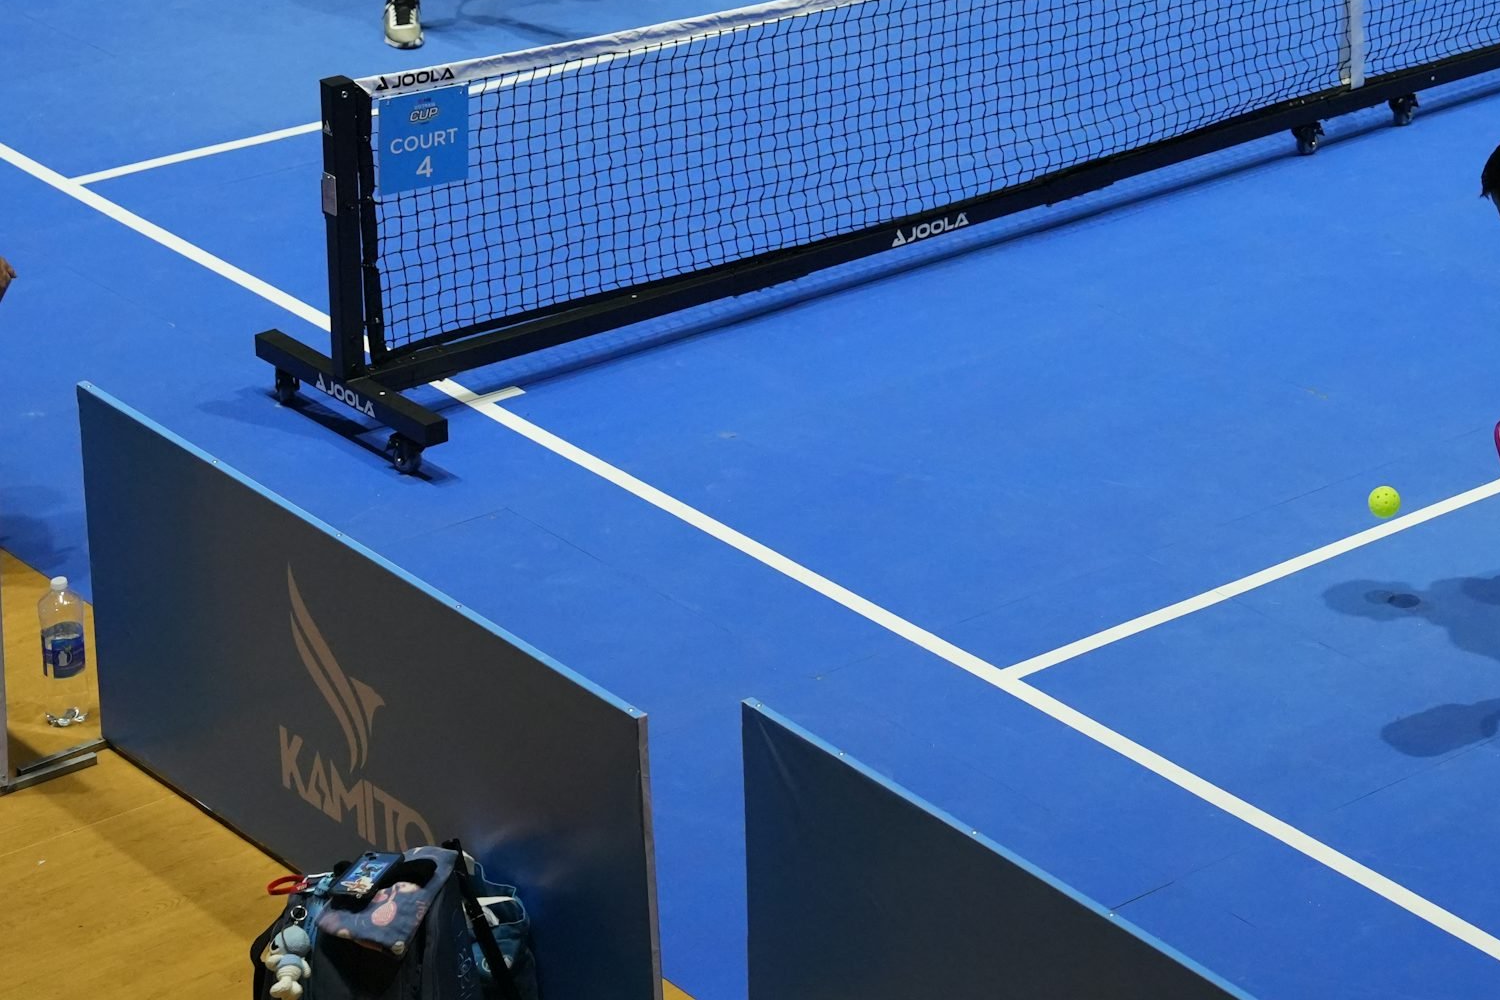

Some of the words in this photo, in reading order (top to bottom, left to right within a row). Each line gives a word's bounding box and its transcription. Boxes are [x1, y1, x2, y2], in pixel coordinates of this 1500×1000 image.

[391, 67, 455, 89] JOOLA
[410, 107, 438, 123] CUP
[390, 127, 459, 155] COURT
[416, 156, 433, 178] 4
[906, 212, 969, 243] JOOLA
[327, 381, 376, 418] JOOLA
